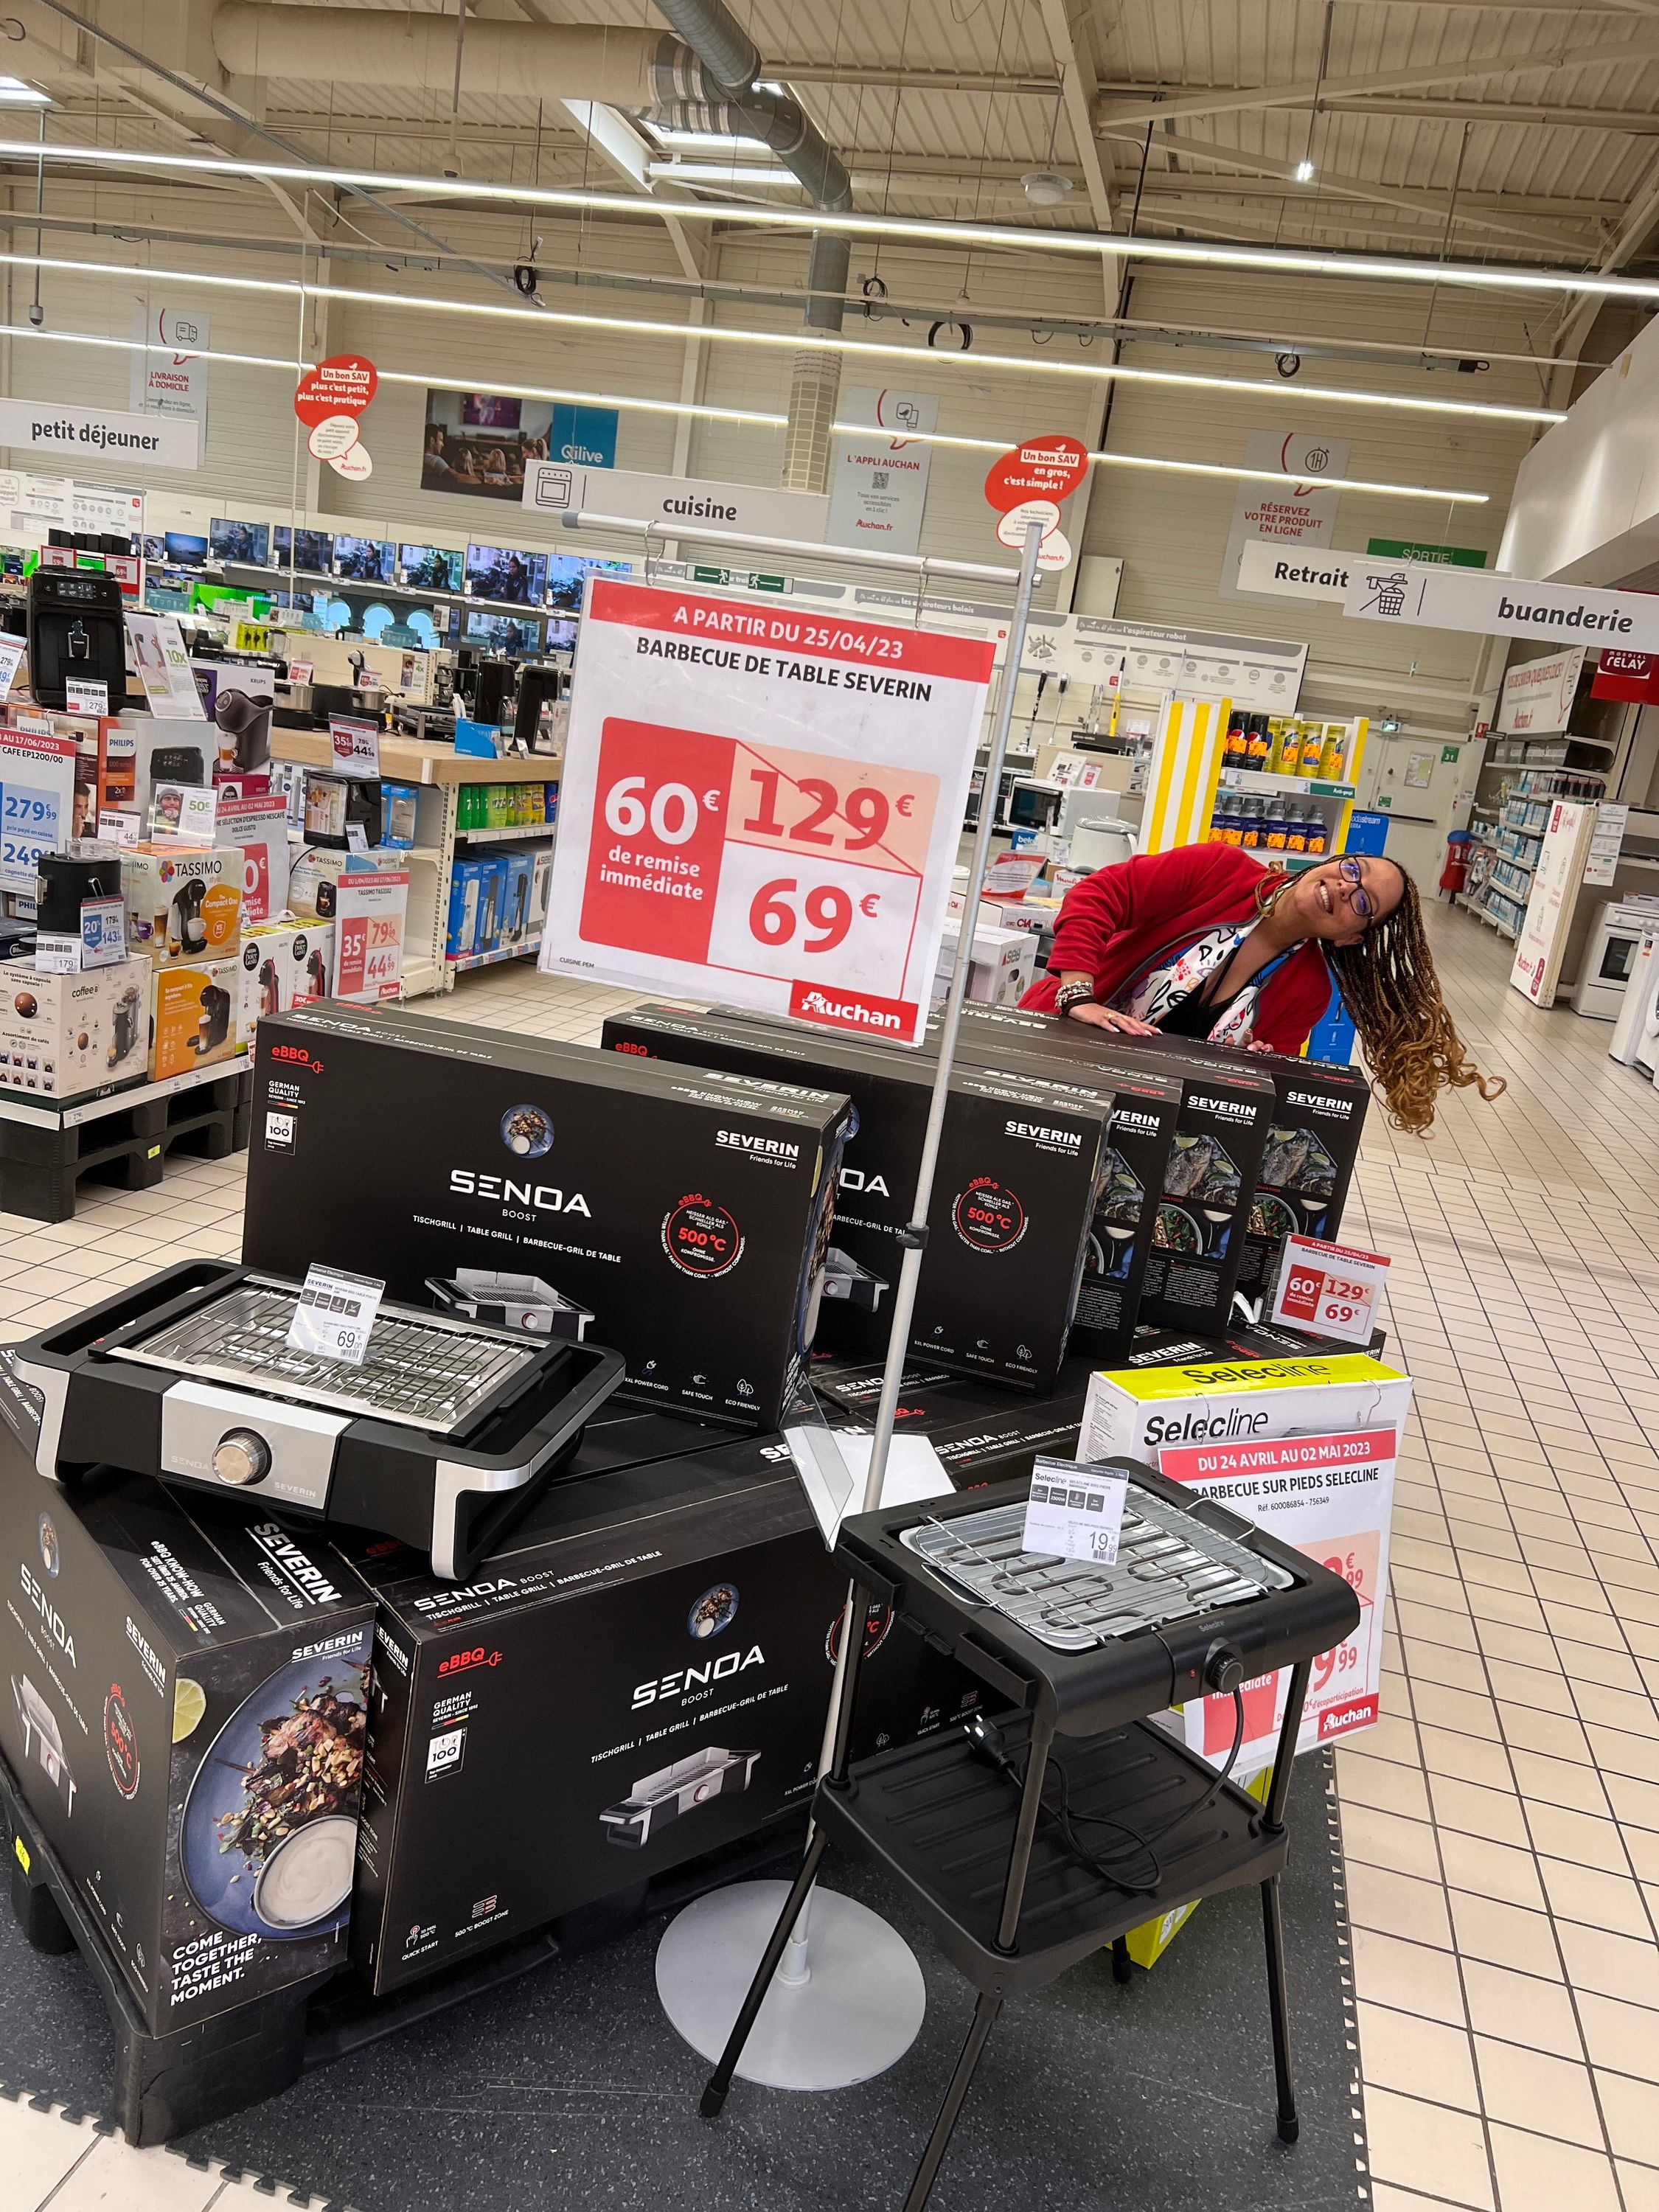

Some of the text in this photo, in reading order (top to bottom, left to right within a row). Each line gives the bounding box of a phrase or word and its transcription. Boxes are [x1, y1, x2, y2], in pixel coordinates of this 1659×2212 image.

[150, 372, 189, 382] LIVRAISON
[335, 371, 350, 380] bon
[352, 372, 367, 380] SAV
[149, 379, 189, 392] À DOMICILE
[311, 381, 369, 394] plus c'est petit,
[298, 392, 366, 406] plus c'est pratique
[32, 420, 159, 451] petit déjeuner
[882, 459, 920, 470] AUCHAN
[1024, 451, 1077, 464] Un bon SAV
[1004, 476, 1025, 486] c'est
[1026, 478, 1057, 490] simple
[1047, 469, 1071, 479] gros,
[663, 495, 737, 521] cuisine
[1260, 501, 1310, 516] RÉSERVEZ
[856, 519, 893, 531] Auchan.fr
[1245, 512, 1323, 528] VOTRE PRODUIT
[1259, 524, 1303, 537] EN LIGNE
[1402, 549, 1450, 564] SORTIE
[1274, 563, 1349, 588] Retrait
[901, 597, 911, 605] les
[953, 605, 975, 613] balais
[1498, 597, 1633, 633] buanderie
[674, 606, 903, 659] A PARTIR DU 25/04/23
[1124, 626, 1164, 639] l'aspirateur
[1166, 633, 1186, 641] robot
[637, 637, 932, 701] BARBECUE DE TABLE SEVERIN
[4, 734, 60, 751] AU 17/06/2023
[109, 739, 133, 747] PHILIPS
[3, 747, 63, 763] CAFE EP1200/00
[267, 812, 285, 820] NESCAFÉ
[175, 860, 222, 877] TASSIMO
[316, 857, 342, 866] TASSIMO
[608, 846, 700, 877] de remise
[5, 869, 27, 877] cagnotte
[600, 864, 703, 901] immédiate
[559, 957, 581, 967] CUISINE
[380, 986, 397, 995] Auchan
[801, 992, 901, 1029] Auchan
[271, 1046, 309, 1062] eBBQ
[268, 1080, 299, 1091] GERMAN
[268, 1088, 299, 1097] QUALITY
[703, 1073, 830, 1100] SEVERIN
[1188, 1096, 1256, 1116] SEVERIN
[1287, 1091, 1353, 1111] SEVERIN
[1005, 1121, 1082, 1145] SEVERIN
[716, 1130, 799, 1157] SEVERIN
[450, 1169, 592, 1218] SENOA
[502, 1209, 537, 1222] BOOST
[413, 1214, 621, 1264] TISCHGRILL TABLE GRILL BARBECUE-GRIL DE TABLE
[1301, 1248, 1327, 1257] BARBECUE
[1354, 1261, 1375, 1269] SEVERIN
[1316, 1243, 1335, 1251] PARTIR
[1345, 1249, 1368, 1260] 25/04/23
[1287, 1297, 1315, 1307] immédiate
[1129, 1342, 1203, 1365] SEVERIN
[1182, 1363, 1329, 1385] Selecline
[1144, 1410, 1268, 1446] Selecline
[1198, 1441, 1371, 1471] DU 24 AVRIL AU 02 MAI 2023
[1035, 1473, 1066, 1484] Selecline
[1263, 1480, 1287, 1495] SUR
[1290, 1475, 1323, 1491] PIEDS
[1326, 1467, 1379, 1486] SELECLINE
[274, 1482, 316, 1498] SEVERIN
[1258, 1497, 1329, 1512] Réf. 600086854 756349
[254, 1523, 342, 1604] SEVERIN
[414, 1571, 555, 1612] SENOA BOOST
[127, 1616, 166, 1683] SEVERIN
[292, 1631, 363, 1659] SEVERIN
[631, 1645, 765, 1710] SENOA
[434, 1691, 472, 1709] GERMAN
[681, 1688, 714, 1706] BOOST
[433, 1699, 471, 1717] QUALITY
[591, 1684, 788, 1763] TISCHGRILL TABLE GRILL BARBECUE-GRIL DE TABLE
[1323, 1706, 1371, 1731] Auchan
[433, 1747, 456, 1761] 100
[172, 1933, 262, 1976] TOGETHER,
[173, 1932, 223, 1960] COME
[171, 1949, 255, 1990] TASTE THE
[170, 1968, 246, 2006] MOMENT.
